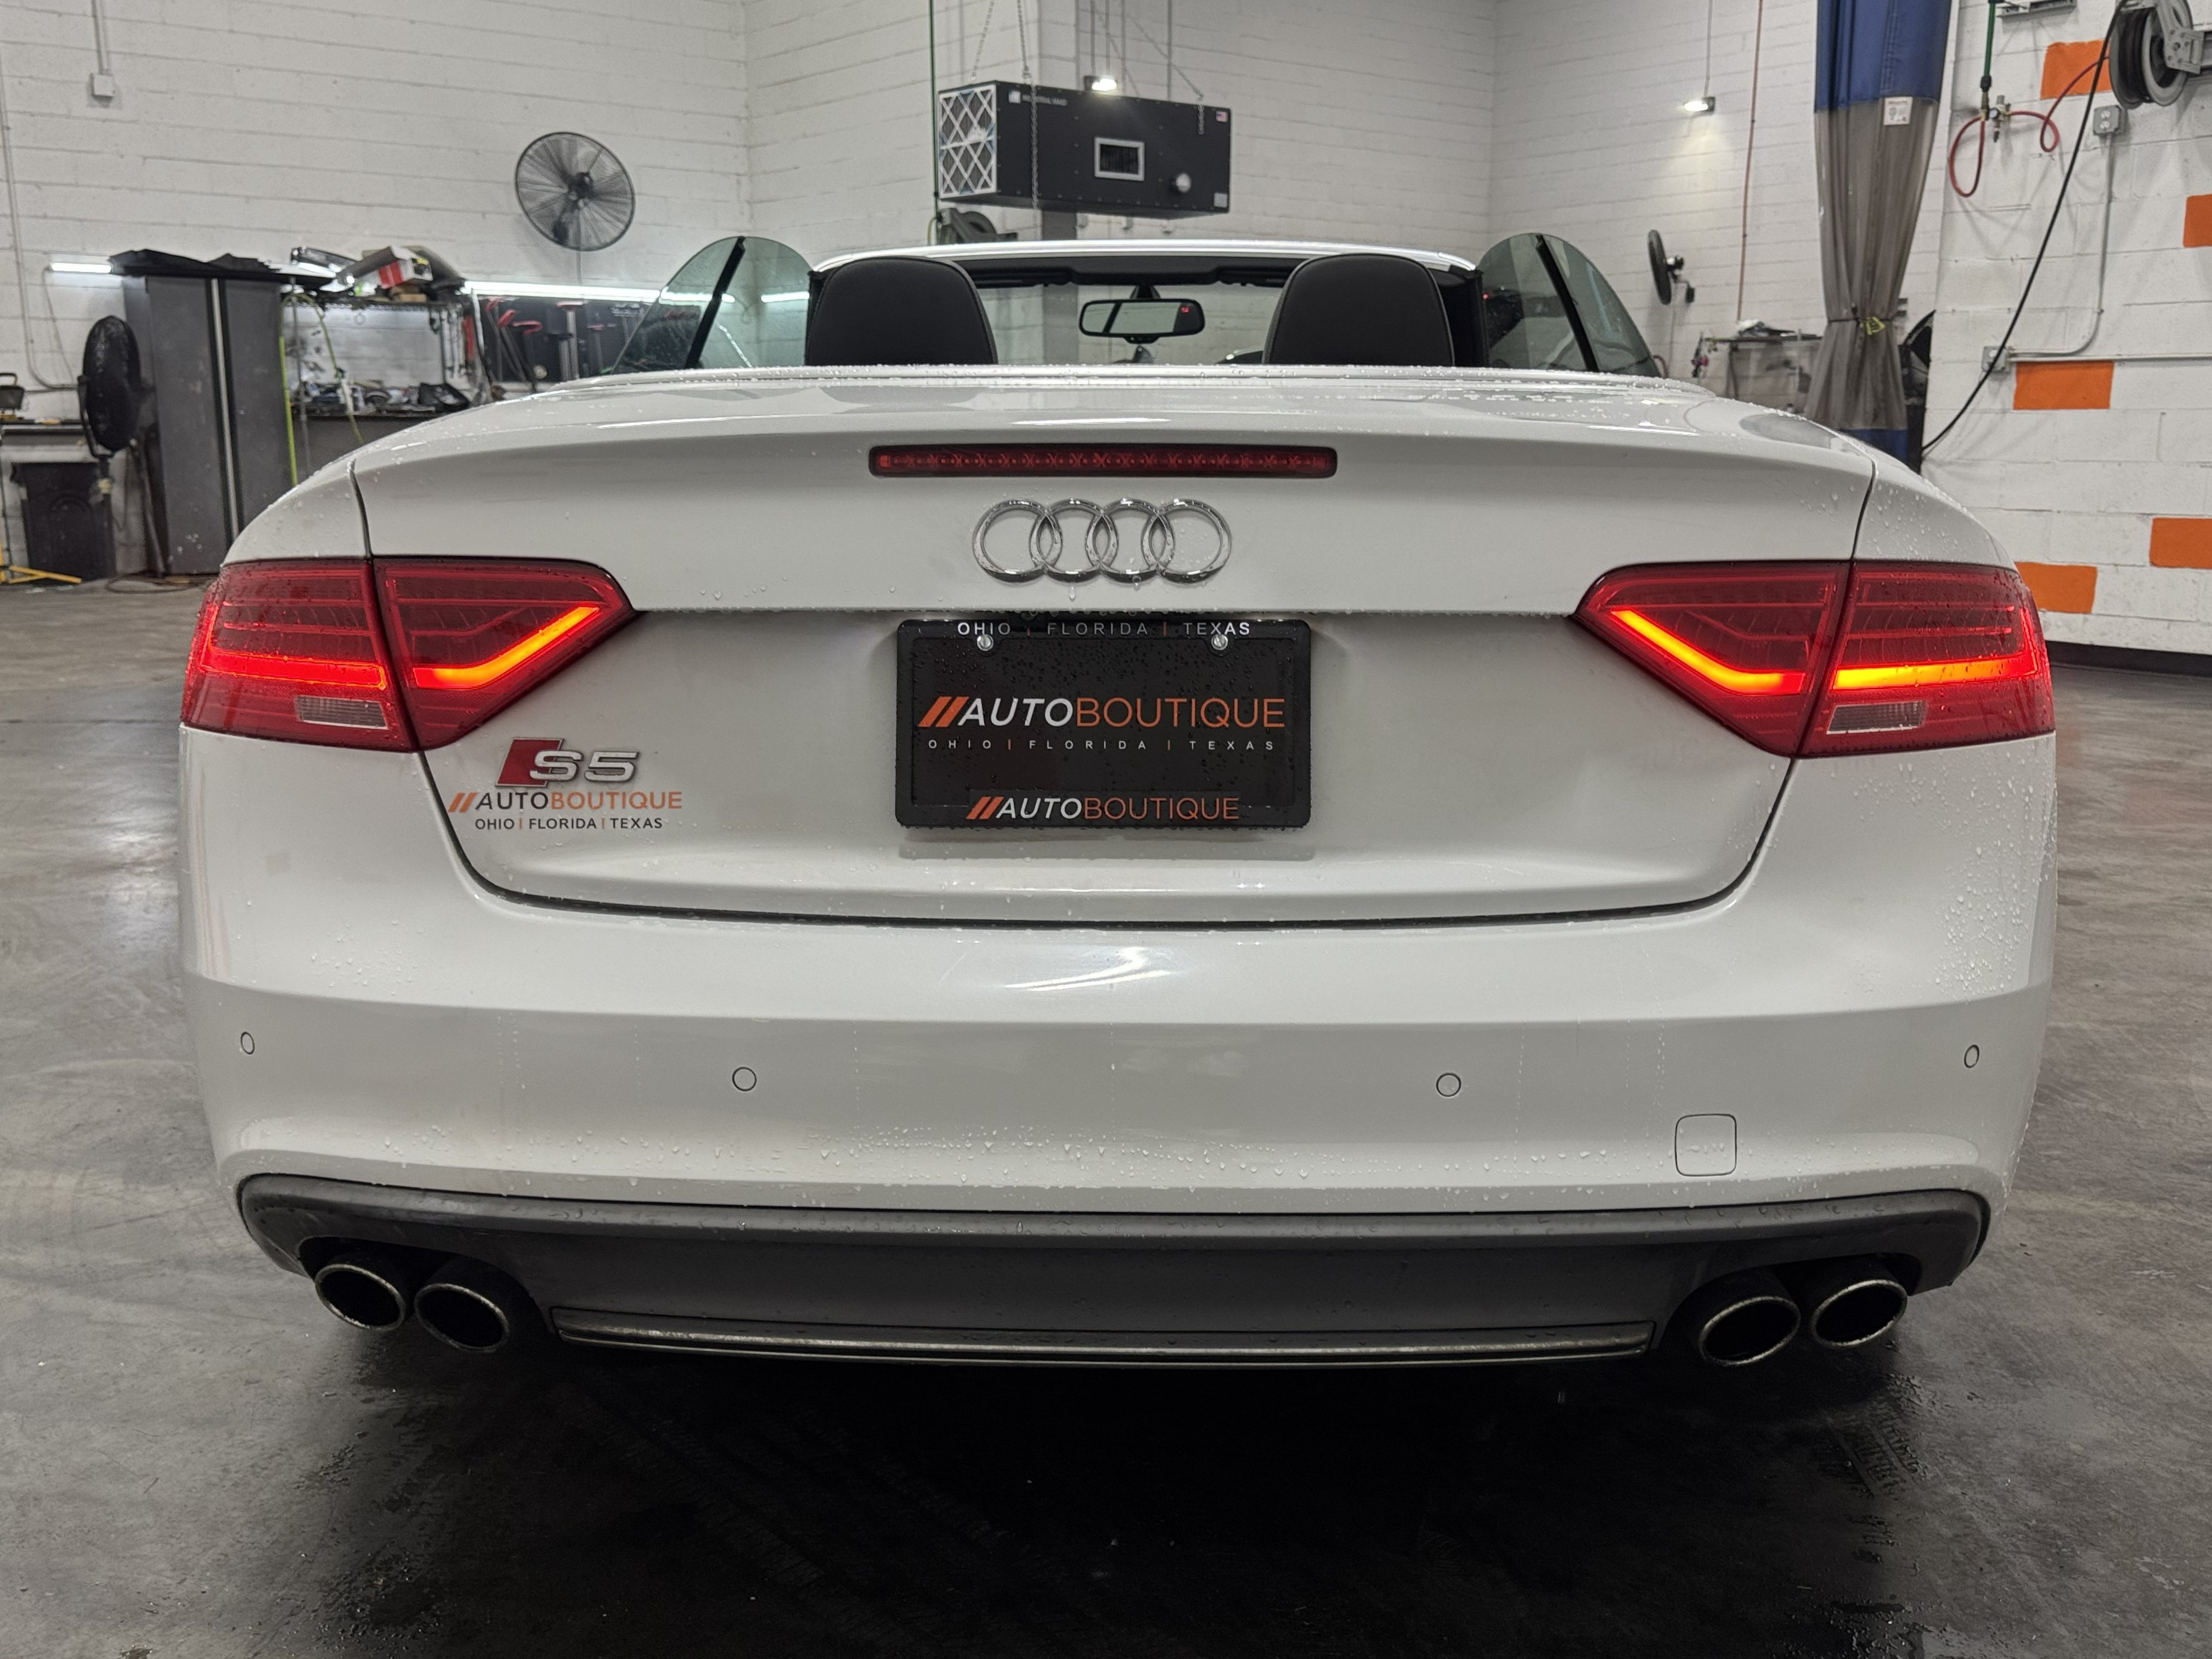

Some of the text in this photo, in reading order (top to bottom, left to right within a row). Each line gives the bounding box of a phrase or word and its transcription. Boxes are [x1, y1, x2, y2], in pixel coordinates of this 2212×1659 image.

[957, 622, 1250, 635] OHIO FLORIDA TEXAS
[928, 740, 1273, 750] OHIO FLORIDA TEXAS
[529, 751, 640, 782] S5
[475, 817, 663, 830] OHIO FLORIDA TEXAS
